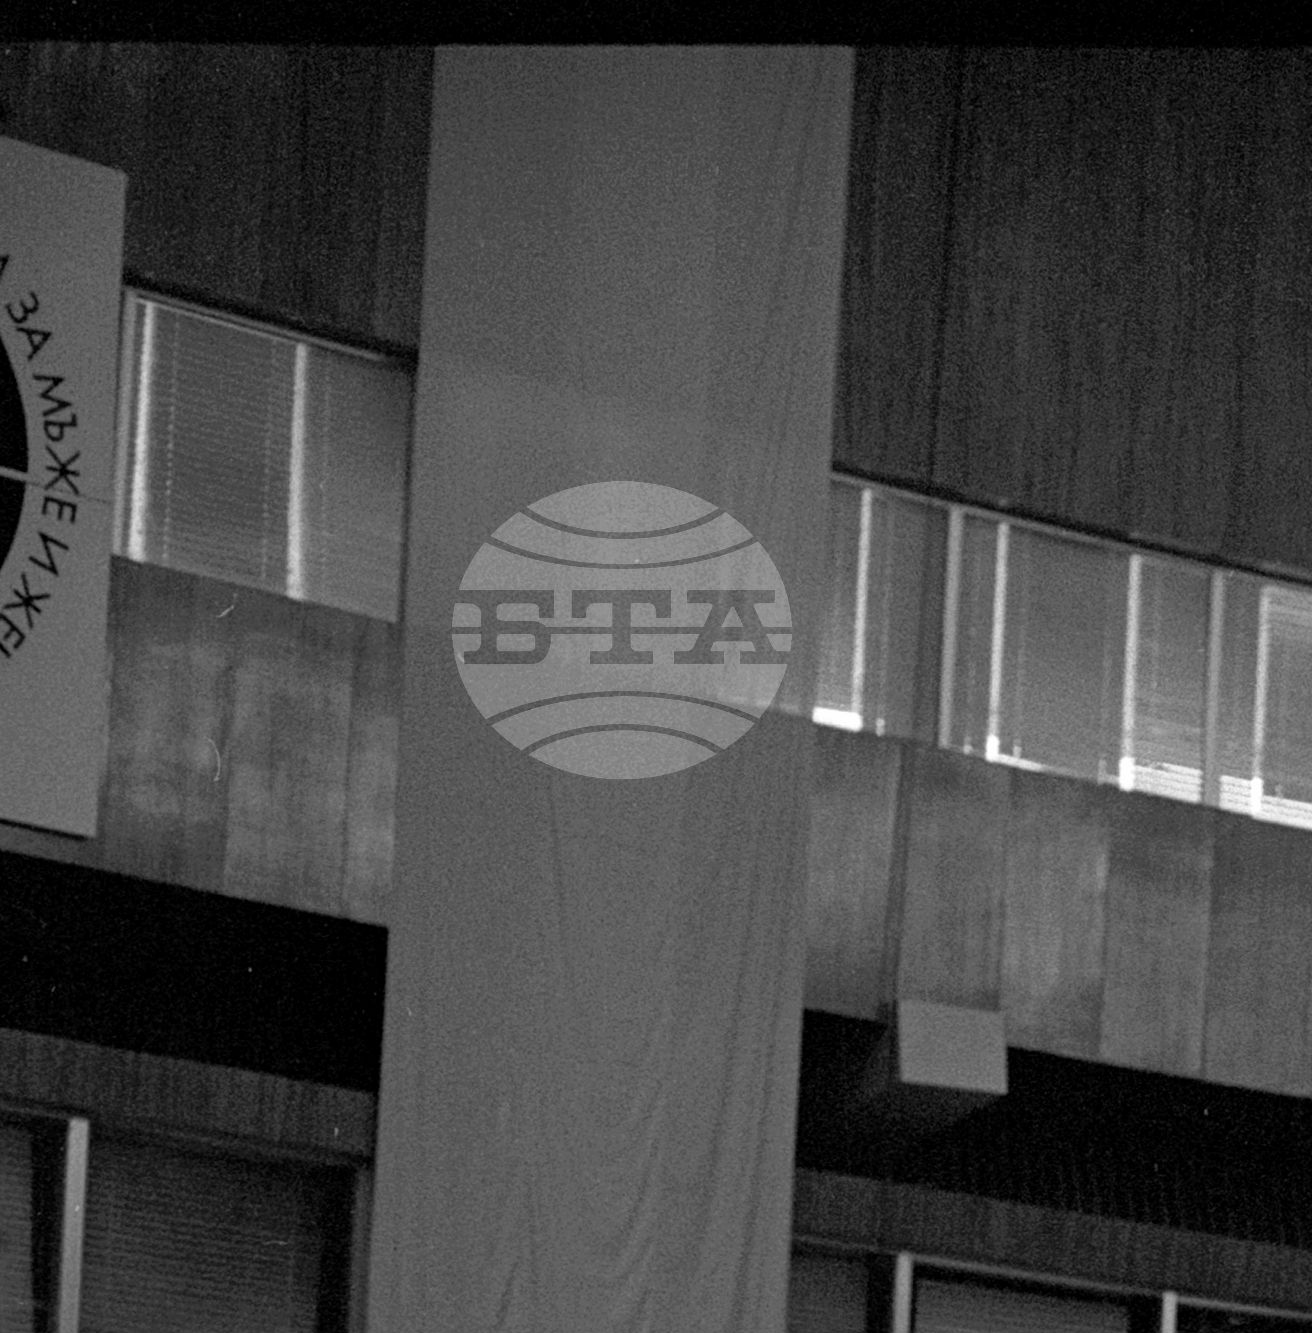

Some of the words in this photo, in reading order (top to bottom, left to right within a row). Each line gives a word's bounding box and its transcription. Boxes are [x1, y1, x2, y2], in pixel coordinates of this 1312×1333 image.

[5, 291, 52, 361] ЗА
[32, 373, 81, 523] МЪЖЕ
[28, 531, 70, 577] И
[0, 572, 52, 659] ЖЕ
